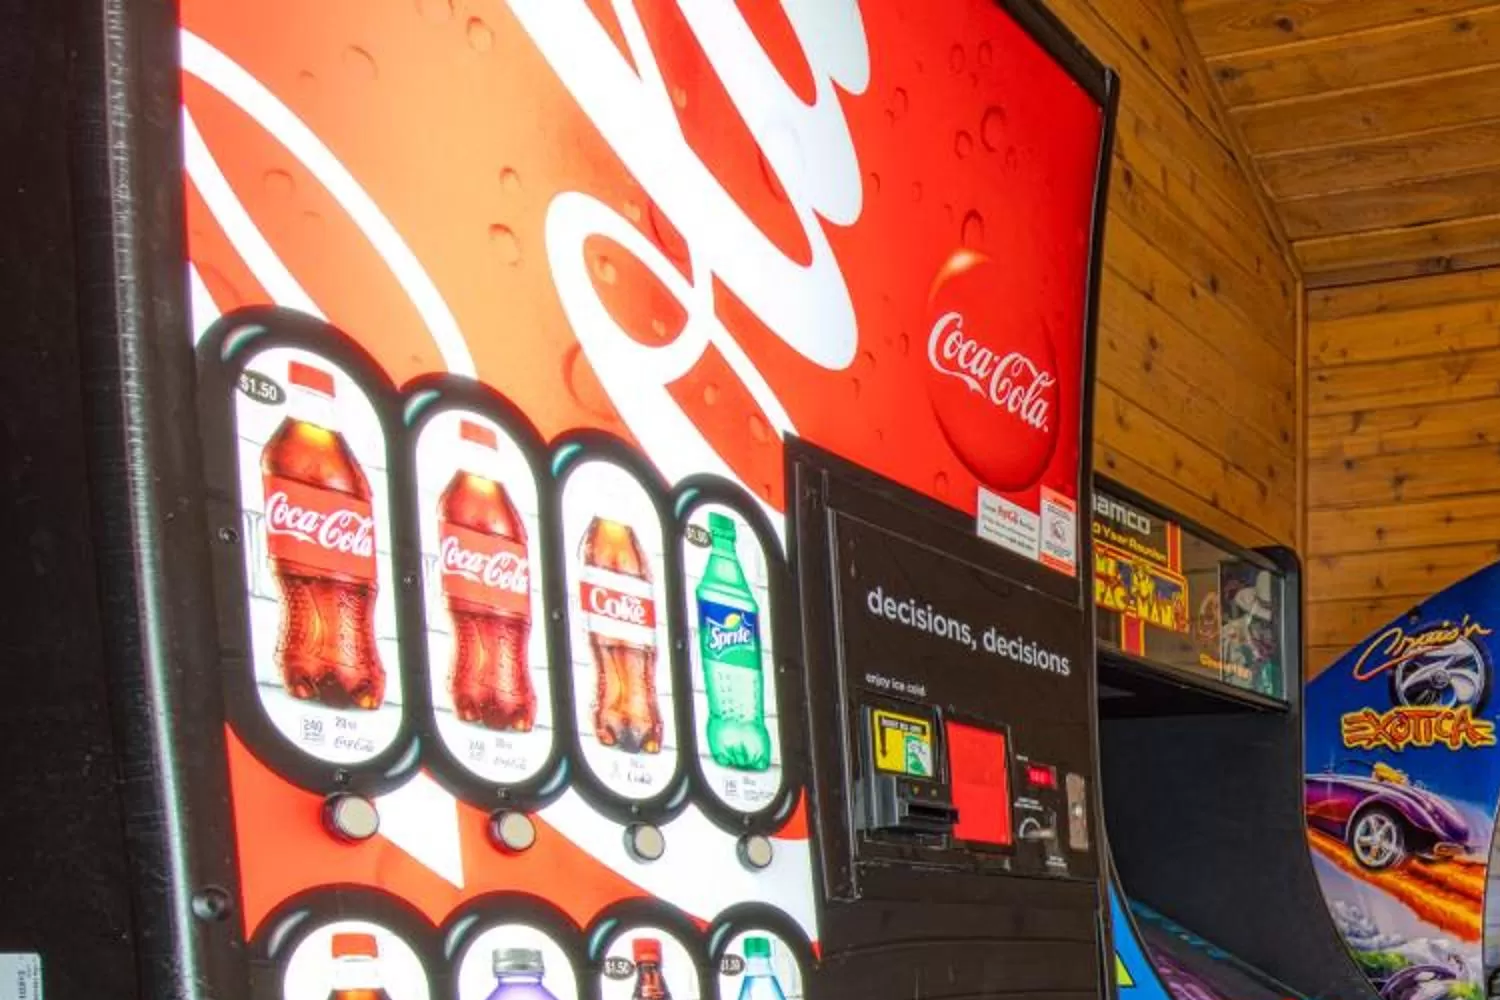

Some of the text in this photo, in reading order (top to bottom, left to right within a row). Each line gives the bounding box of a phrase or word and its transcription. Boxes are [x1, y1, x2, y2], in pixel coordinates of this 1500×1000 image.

[239, 373, 279, 401] $1.50
[927, 311, 1057, 433] Coca-Cola
[265, 491, 376, 559] Coca-Cola
[440, 535, 529, 594] Coca-Cola
[589, 588, 647, 626] Coke
[866, 584, 1072, 678] decisions, decisions
[708, 623, 752, 652] Sprite
[1341, 706, 1498, 752] EXOTICA
